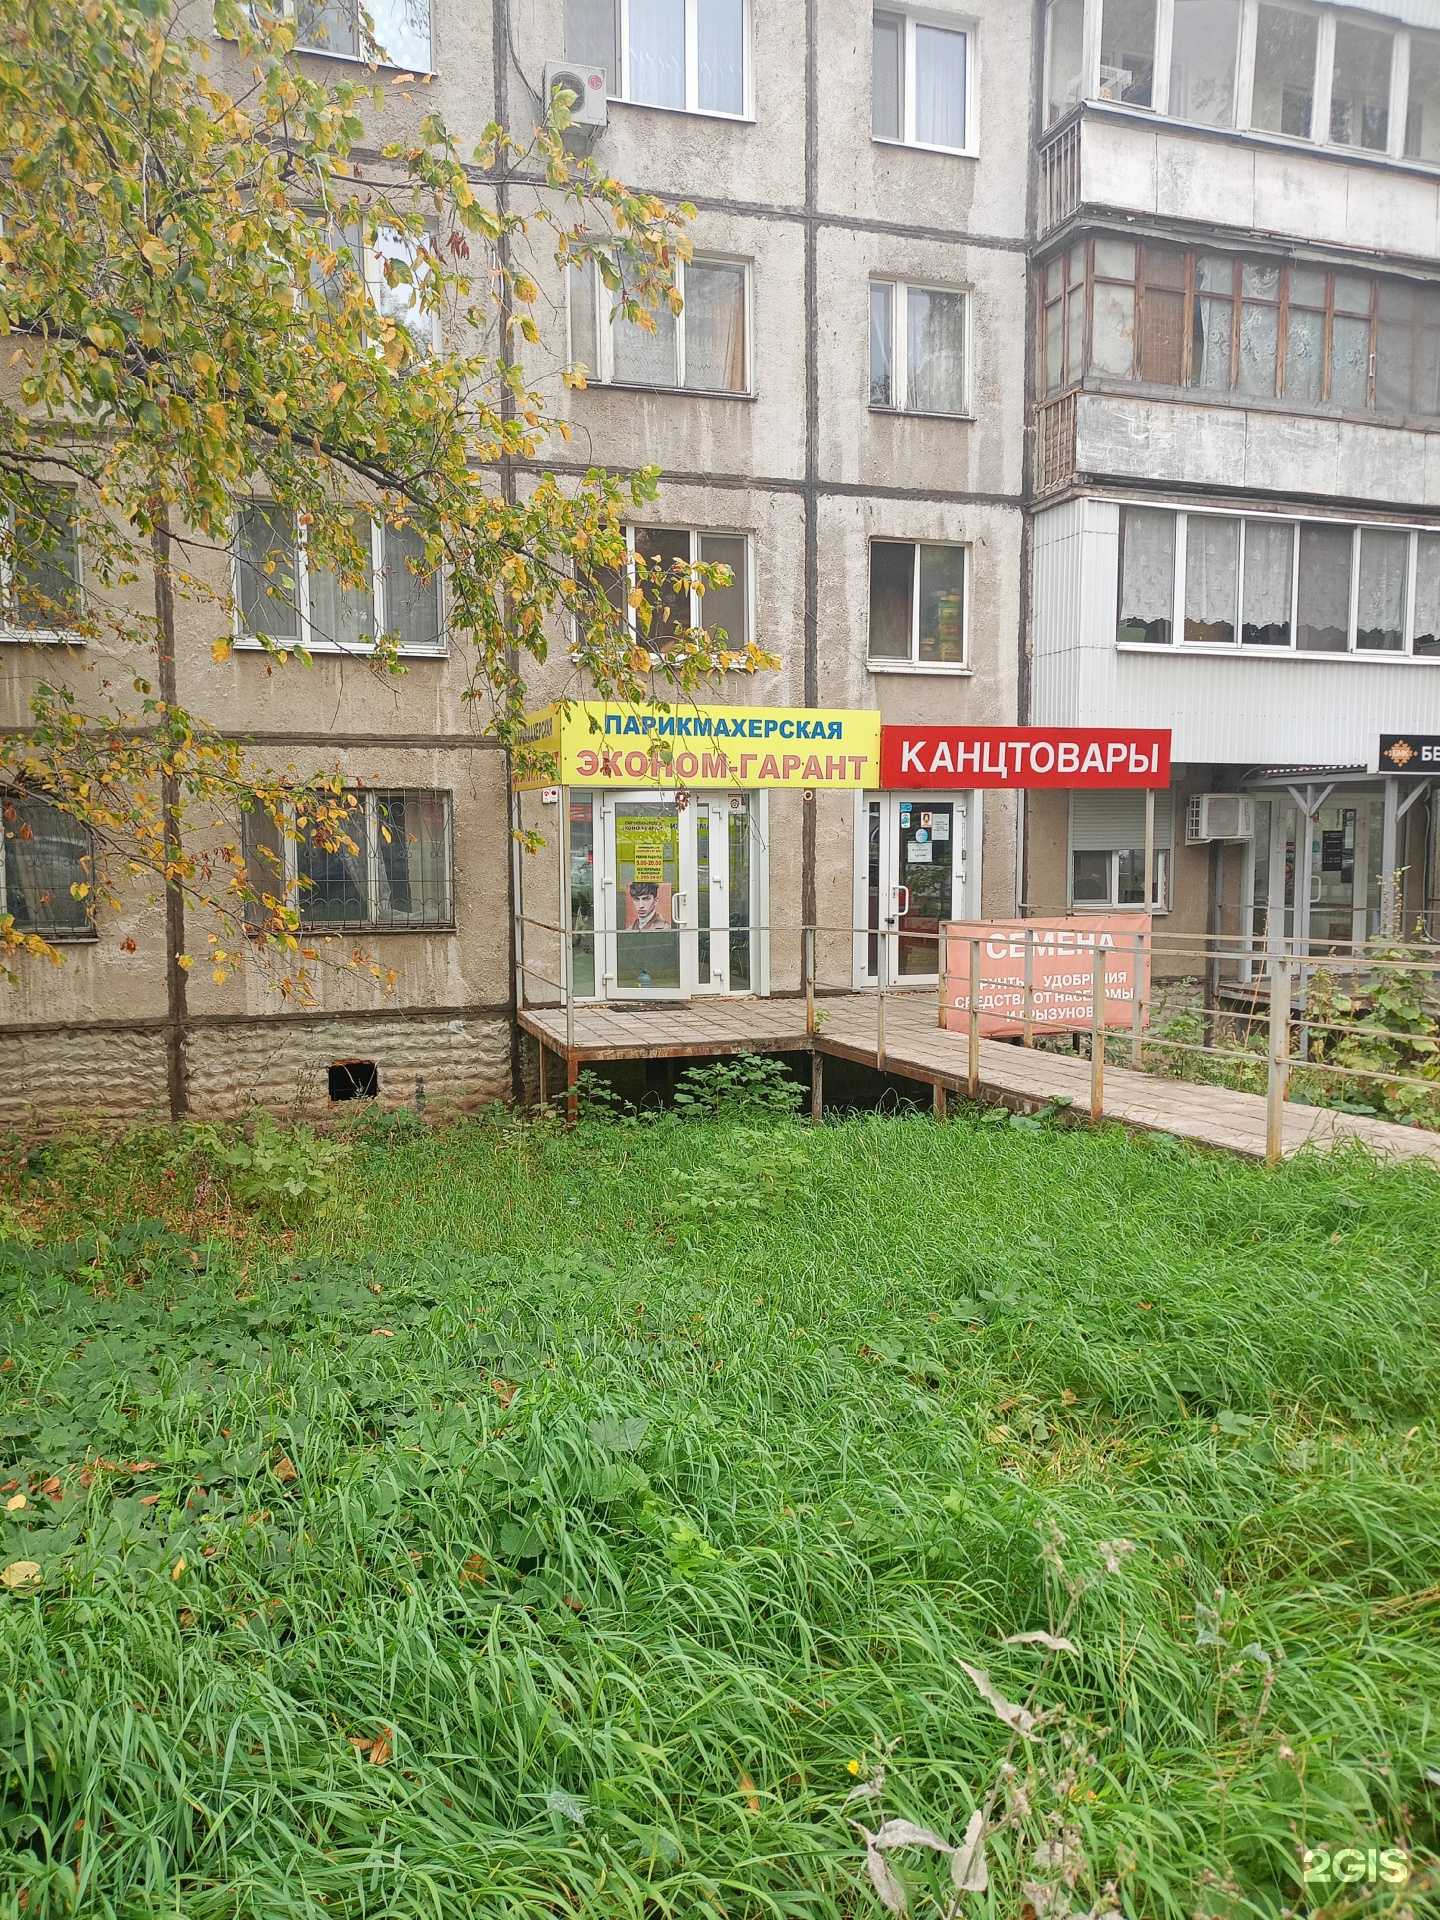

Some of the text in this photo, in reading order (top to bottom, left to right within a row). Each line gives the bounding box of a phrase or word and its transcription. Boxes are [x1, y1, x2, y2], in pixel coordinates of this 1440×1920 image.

[604, 715, 843, 739] ПАРИКМАХЕРСКАЯ
[576, 750, 868, 780] ЭКОНОМ-ГАРАНТ
[901, 741, 1159, 779] КАНЦТОВАРЫ
[986, 932, 1117, 959] СЕМЕНА
[973, 976, 1027, 991] РУНТЫ
[1042, 971, 1128, 990] УДОБРИЯ
[954, 993, 1029, 1009] СРЕДСТВ
[1033, 991, 1052, 1004] ОТ
[1019, 1006, 1094, 1021] ГЫЗУНОВ
